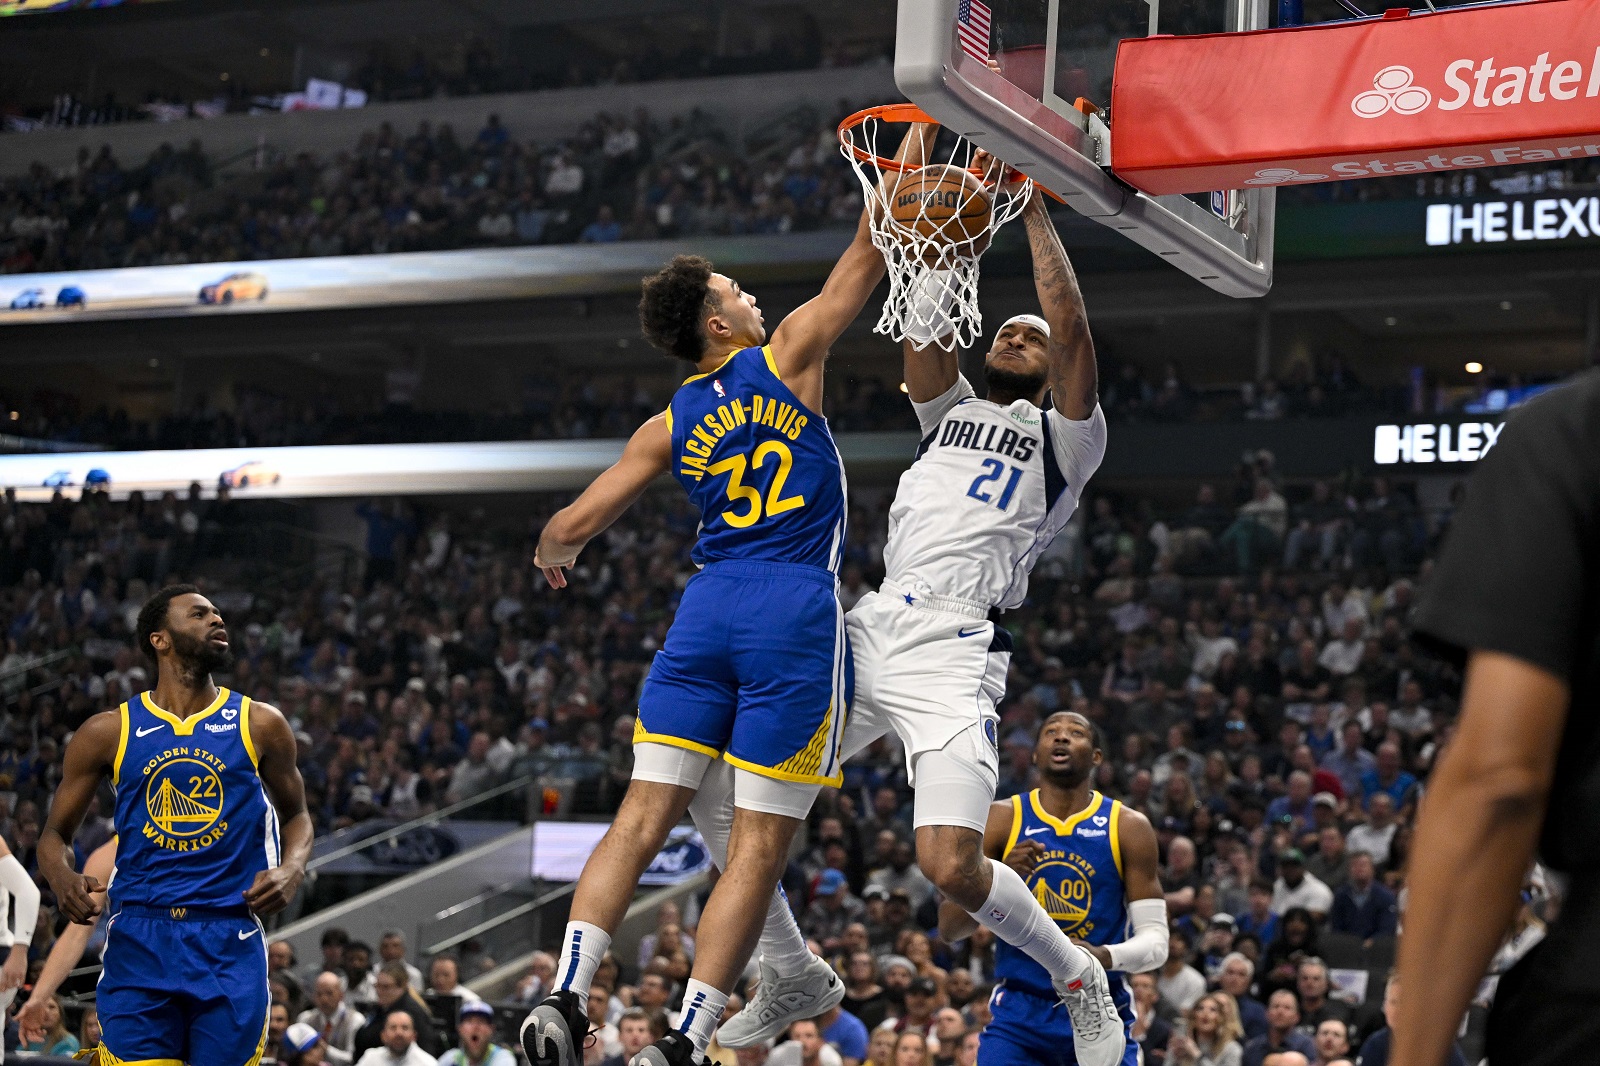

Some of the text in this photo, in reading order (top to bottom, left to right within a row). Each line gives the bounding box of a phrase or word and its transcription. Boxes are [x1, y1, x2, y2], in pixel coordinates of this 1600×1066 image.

[1438, 51, 1583, 111] State
[1331, 154, 1486, 177] State
[898, 190, 967, 211] Wilson
[1010, 411, 1040, 426] chime
[681, 395, 808, 482] JACKSON-DAVIS
[939, 420, 1038, 463] DALLAS
[706, 439, 806, 528] 32
[965, 457, 1025, 513] 21
[204, 722, 237, 733] Rakuten
[142, 747, 227, 776] GOLDEN STATE
[188, 775, 217, 799] 22
[141, 819, 229, 852] WARRIORS
[1035, 850, 1097, 877] LDEN STATE
[1060, 879, 1085, 900] 00
[171, 907, 187, 918] W
